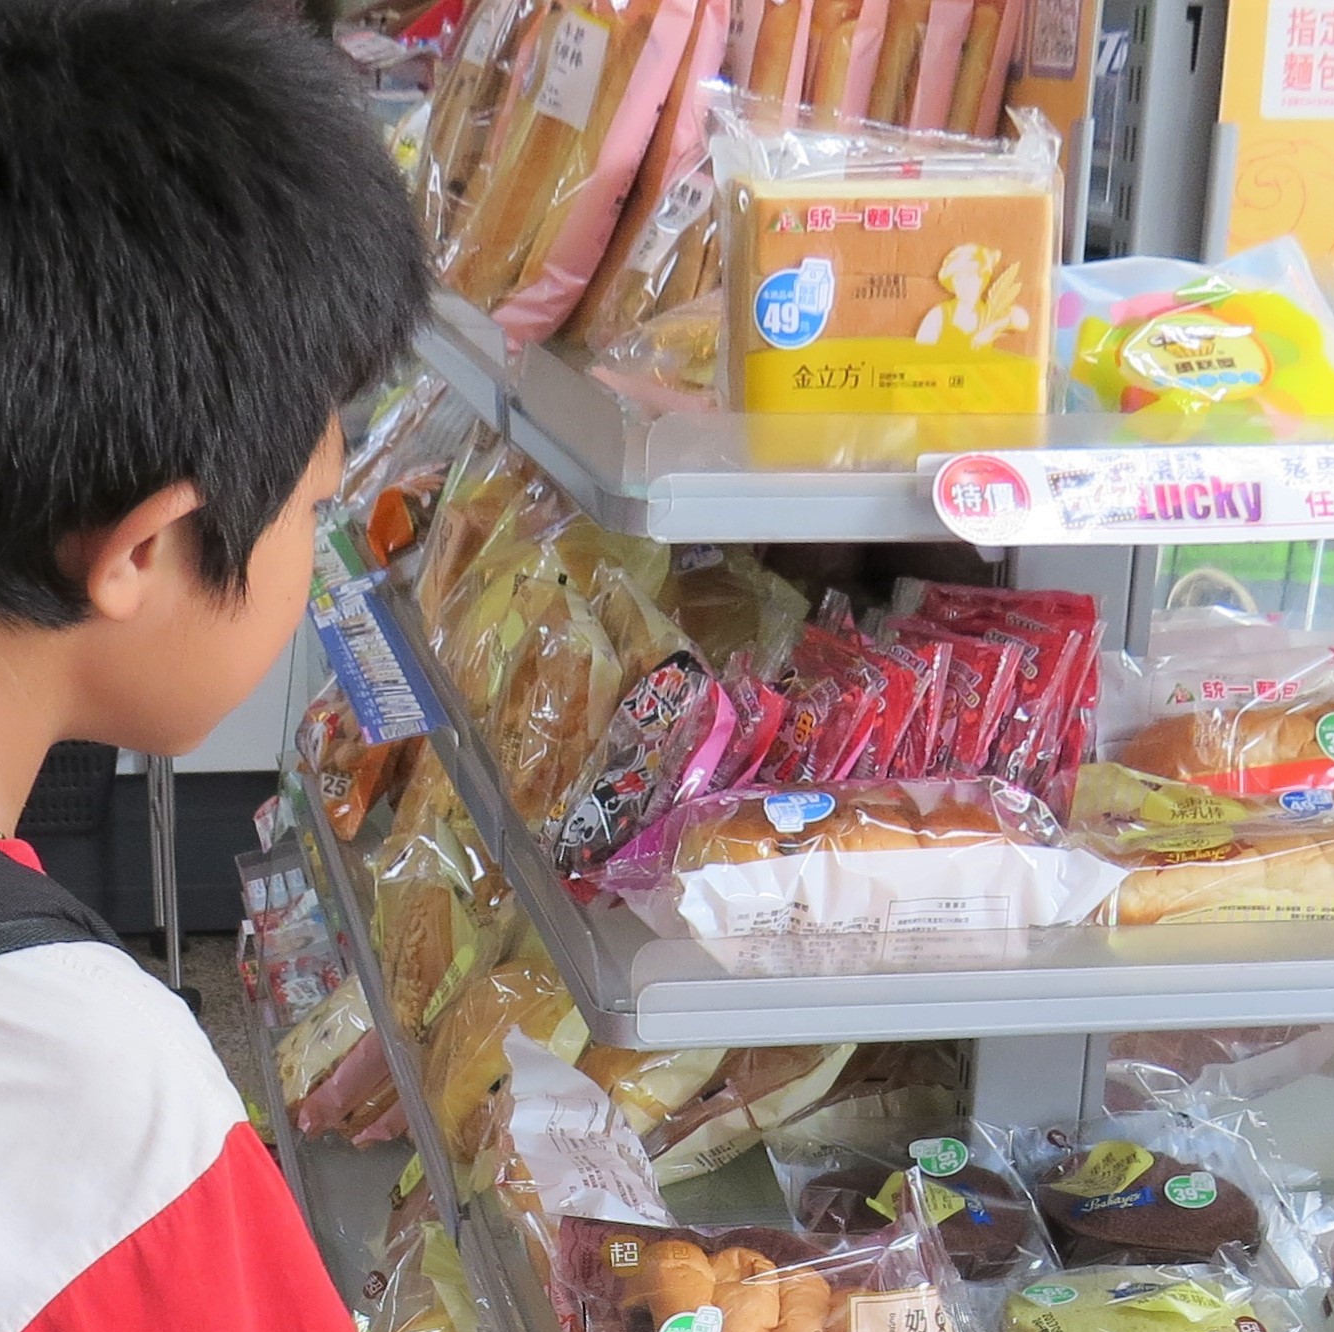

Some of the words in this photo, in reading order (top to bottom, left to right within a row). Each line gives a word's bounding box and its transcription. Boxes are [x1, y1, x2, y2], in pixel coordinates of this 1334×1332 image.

[807, 205, 923, 230] 統一麵包
[763, 302, 799, 333] 49
[792, 364, 861, 390] 金立方
[951, 483, 1016, 513] 特價
[1201, 679, 1302, 701] 統一麵包
[322, 774, 349, 798] 25
[1172, 1187, 1198, 1201] 39
[609, 1242, 639, 1268] 超
